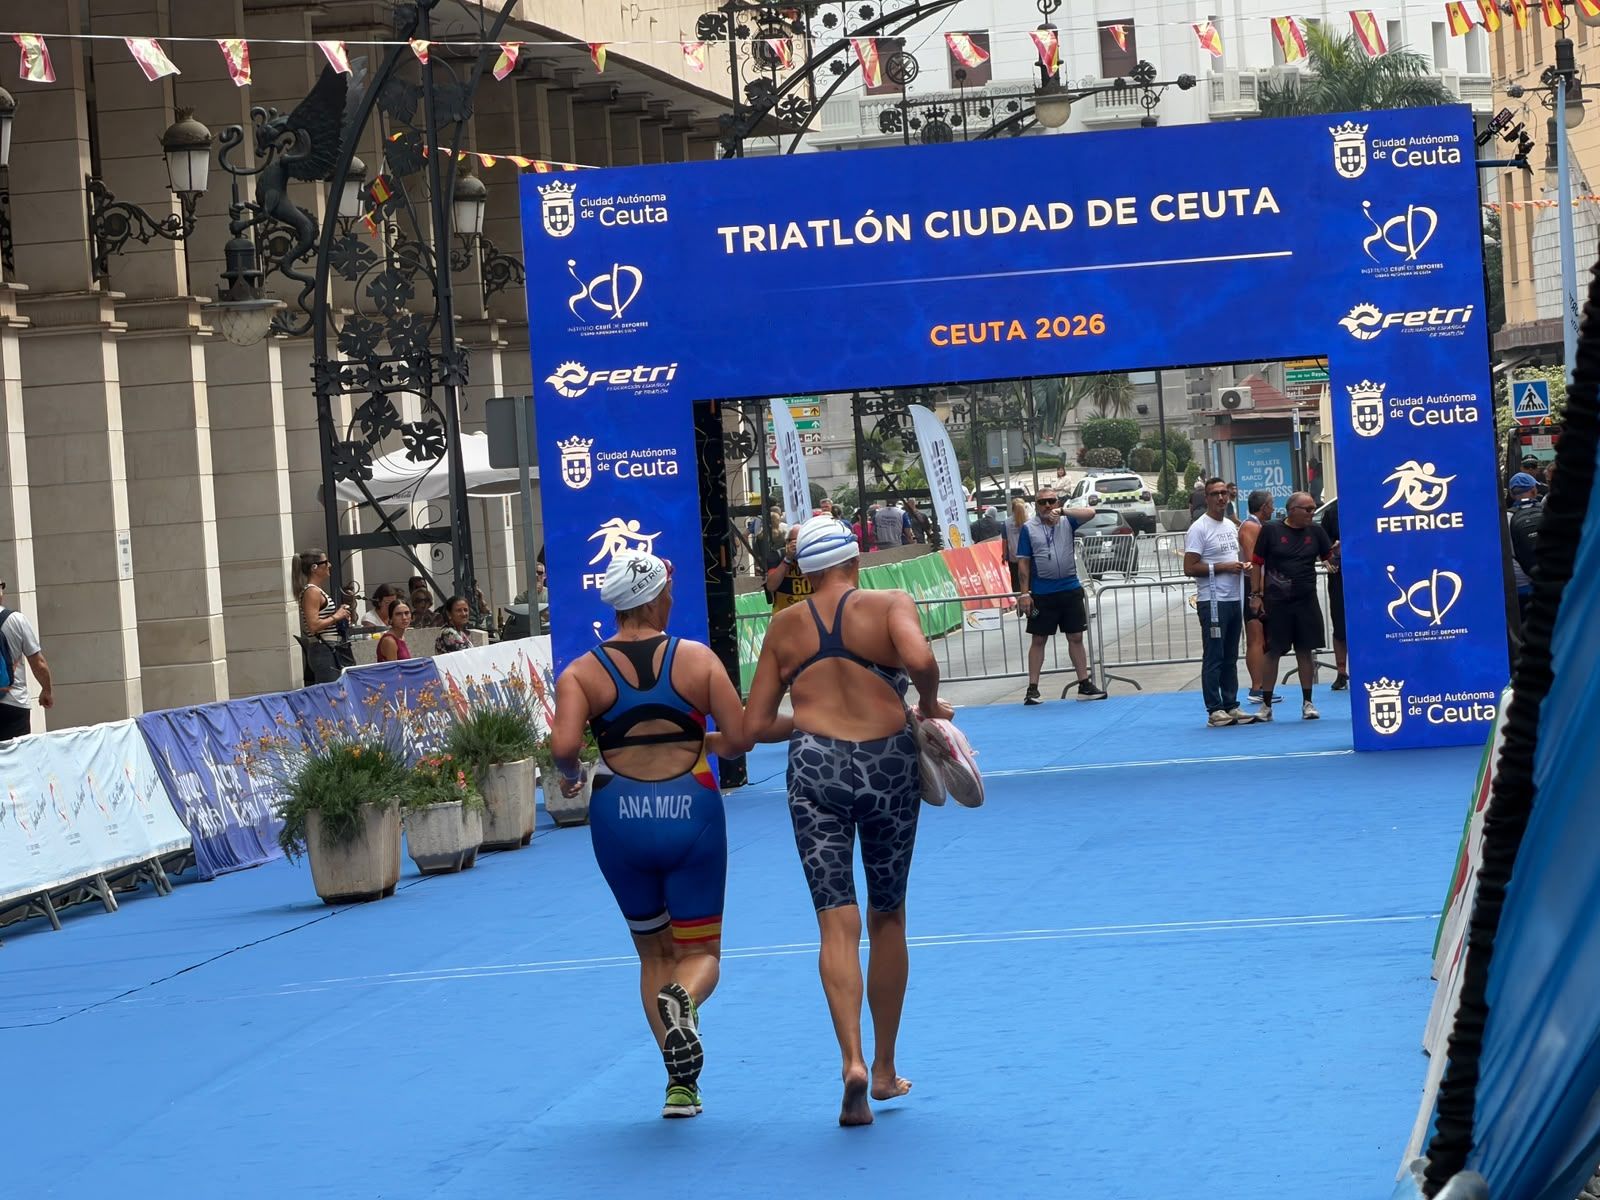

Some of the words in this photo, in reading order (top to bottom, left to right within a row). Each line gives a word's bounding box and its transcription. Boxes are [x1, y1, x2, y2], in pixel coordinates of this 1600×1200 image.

[1372, 138, 1406, 148] Ciudad
[1409, 134, 1459, 146] Autónoma
[1373, 150, 1386, 160] de
[1392, 146, 1461, 168] Ceuta
[580, 197, 614, 208] Ciudad
[616, 193, 666, 204] Autónoma
[580, 209, 594, 218] de
[599, 205, 668, 226] Ceuta
[717, 208, 911, 254] TRIATLÓN
[924, 202, 1074, 239] CIUDAD
[1088, 197, 1138, 227] DE
[1150, 187, 1280, 222] CEUTA
[930, 320, 1027, 346] CEUTA
[1036, 313, 1106, 339] 2026
[1389, 396, 1423, 407] Ciudad
[1426, 393, 1476, 404] Autónoma
[1390, 408, 1404, 418] de
[1408, 404, 1478, 426] Ceuta
[596, 450, 628, 462] Ciudad
[630, 446, 677, 458] Autónoma
[597, 462, 610, 471] de
[614, 458, 678, 479] Ceuta
[1264, 466, 1284, 487] 20
[1376, 512, 1464, 533] FETRICE
[632, 564, 664, 594] FETRICE
[792, 578, 812, 595] 60
[1408, 694, 1442, 704] Ciudad
[1444, 690, 1495, 702] Autónoma
[1408, 706, 1422, 716] de
[1427, 702, 1496, 724] Ceuta
[618, 795, 652, 820] ANA
[655, 794, 692, 820] MUR
